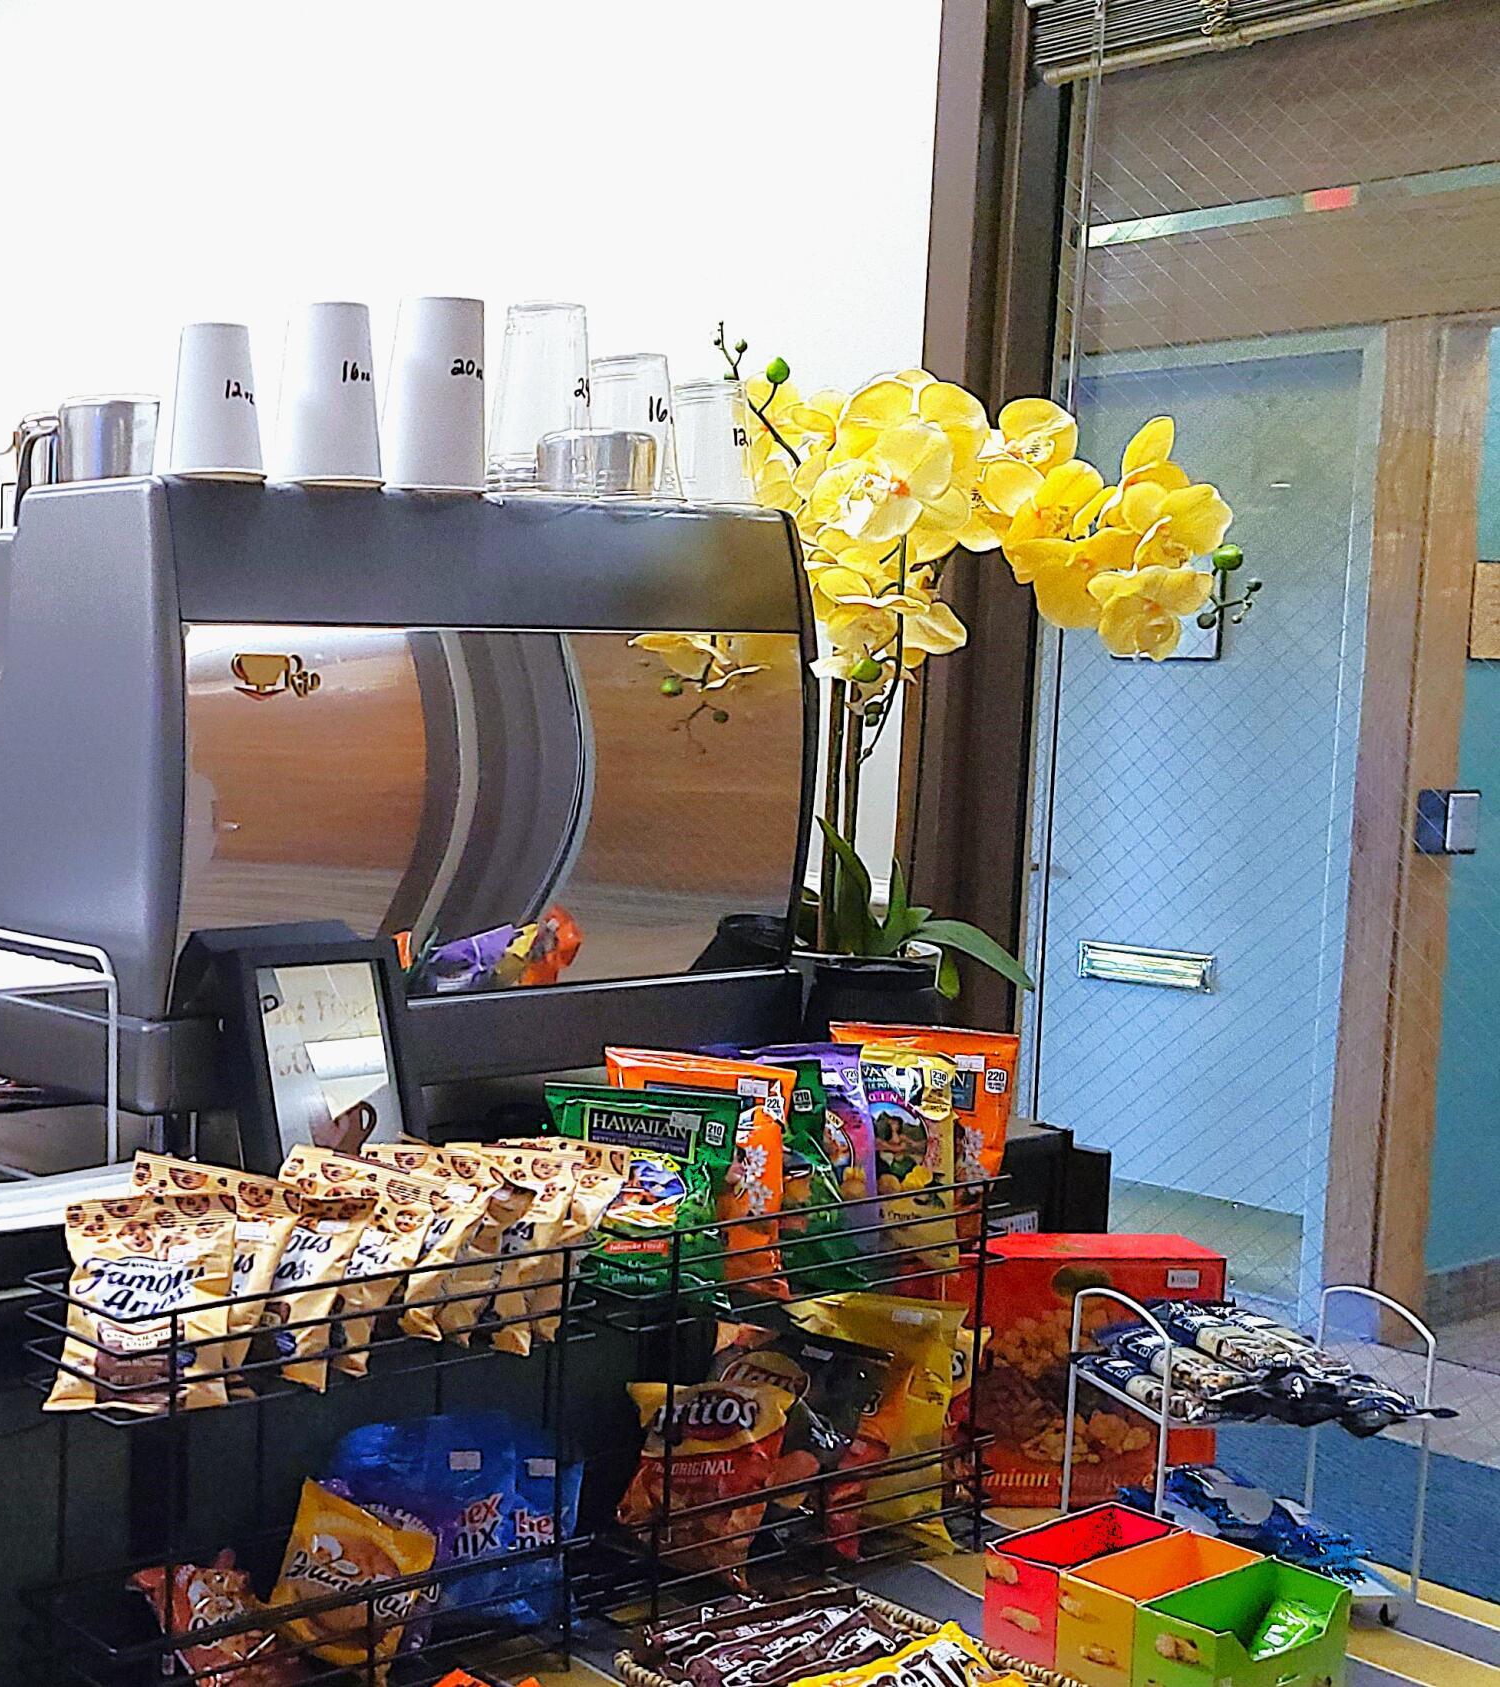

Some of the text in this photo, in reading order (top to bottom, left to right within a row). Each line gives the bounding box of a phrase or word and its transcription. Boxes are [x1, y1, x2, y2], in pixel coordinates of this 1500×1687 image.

[987, 1070, 1005, 1082] 220
[793, 1091, 810, 1102] 210
[592, 1112, 688, 1139] HAWAIIAN
[708, 1123, 723, 1136] 210
[670, 1458, 736, 1476] ORIGINAL
